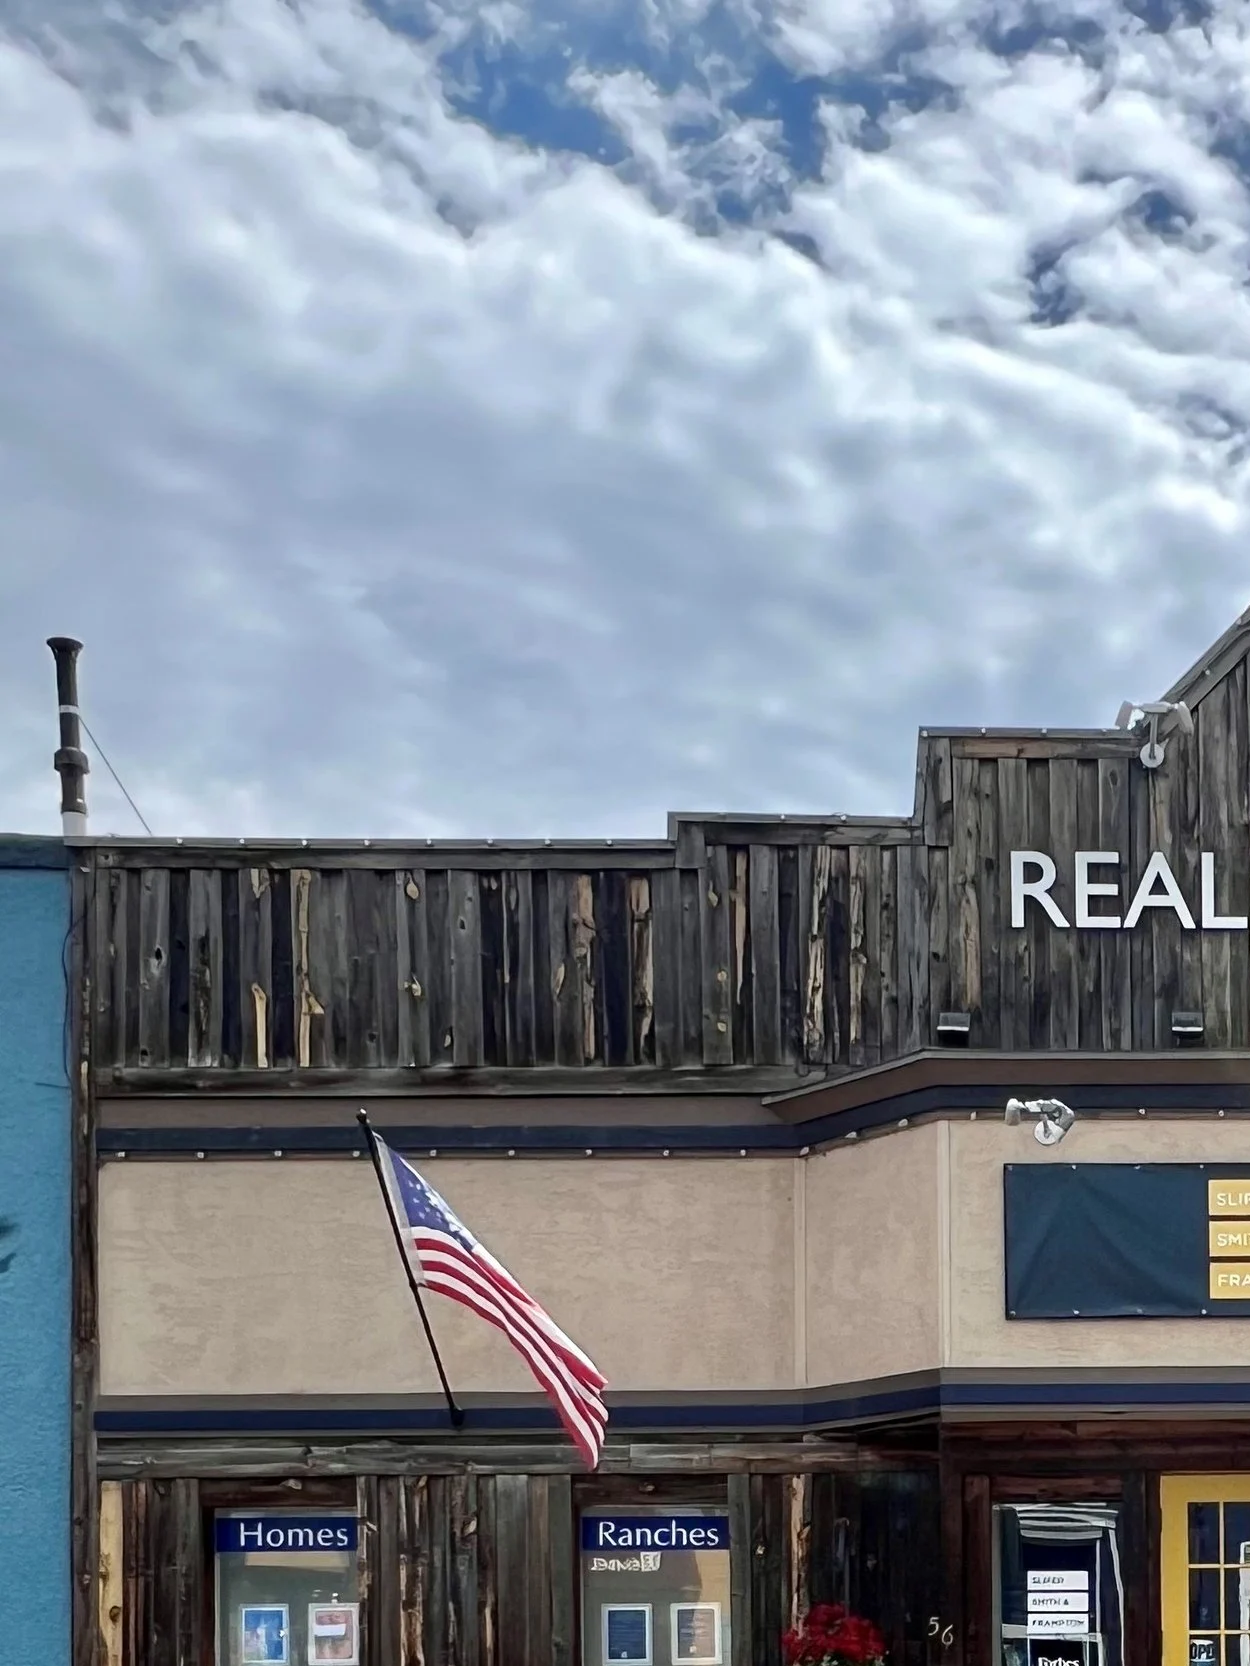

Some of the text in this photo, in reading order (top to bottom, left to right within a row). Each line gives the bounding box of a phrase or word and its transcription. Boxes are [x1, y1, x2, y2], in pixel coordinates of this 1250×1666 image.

[1009, 850, 1249, 930] REAL
[238, 1521, 349, 1548] Homes
[598, 1518, 720, 1547] Ranches
[927, 1616, 954, 1647] 56
